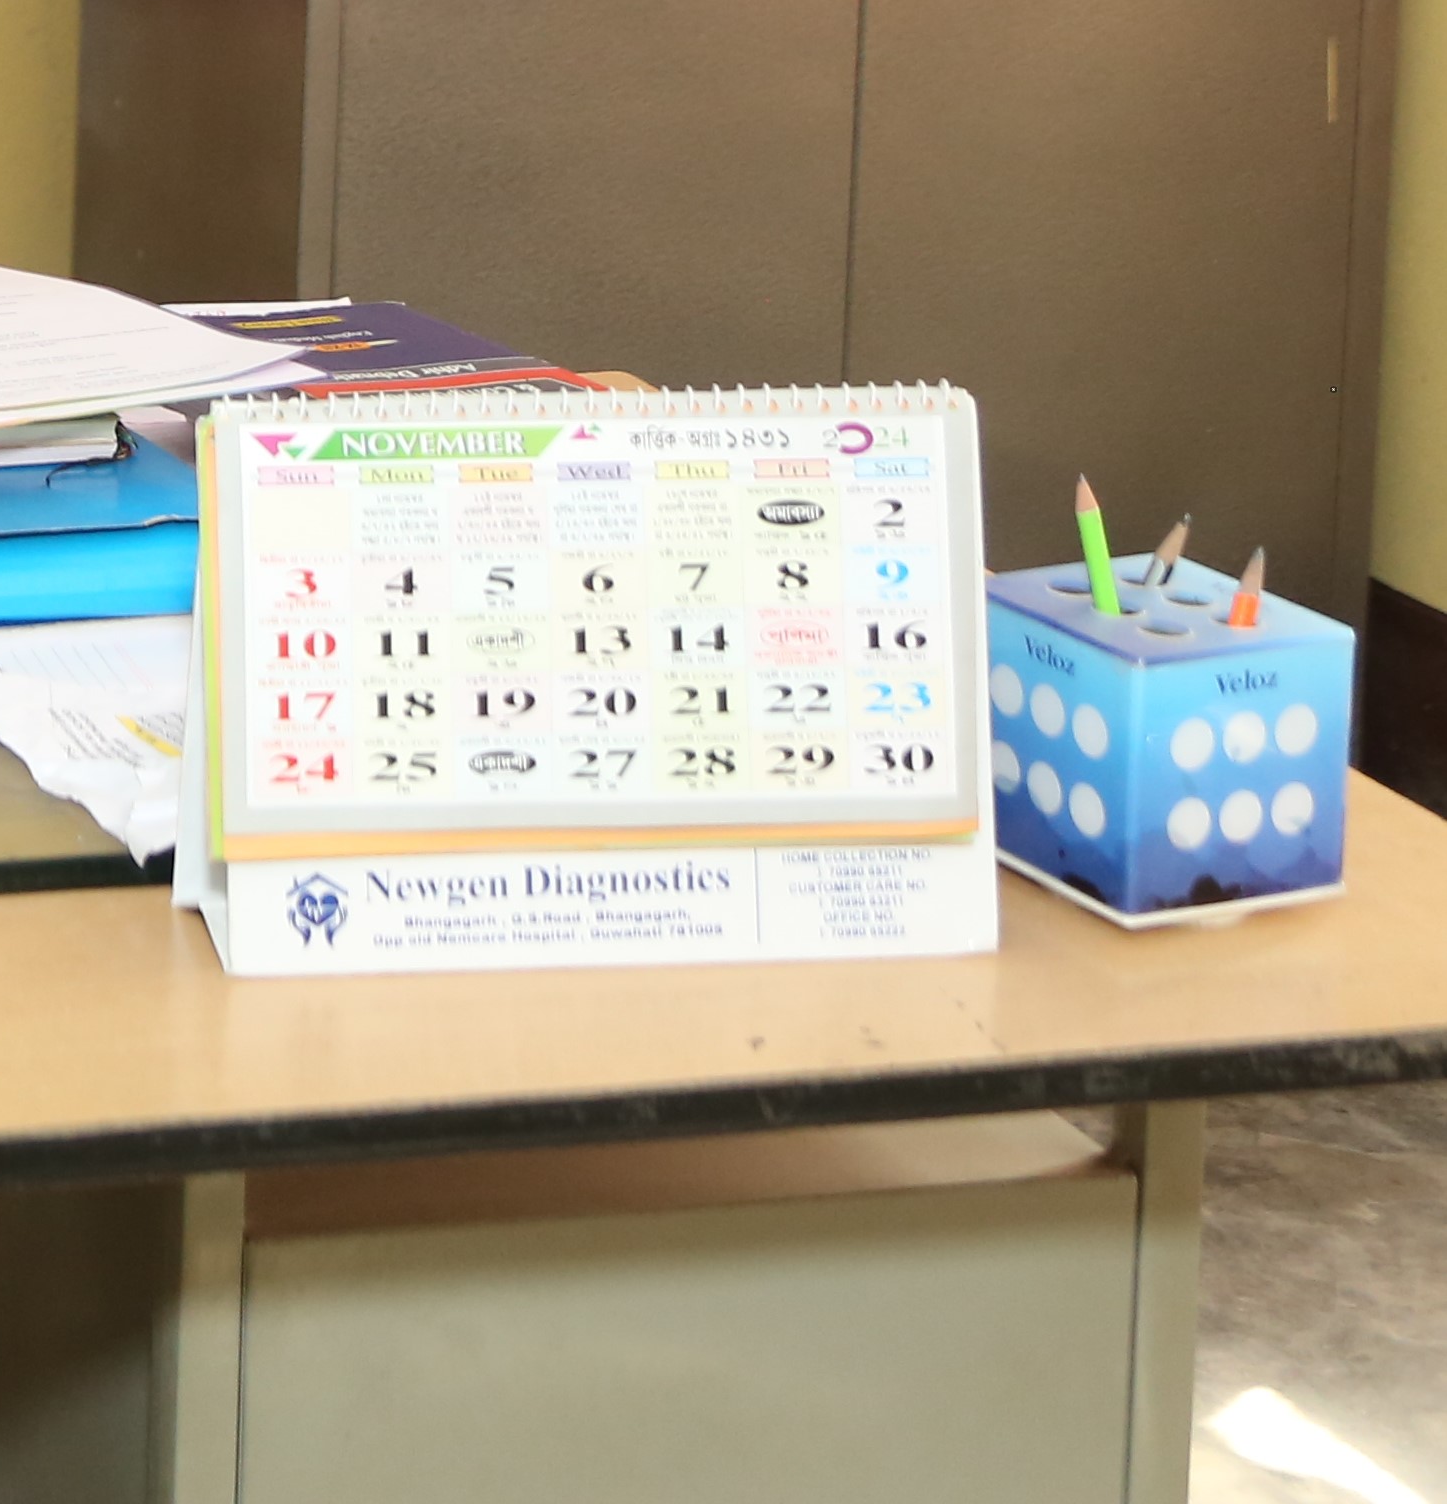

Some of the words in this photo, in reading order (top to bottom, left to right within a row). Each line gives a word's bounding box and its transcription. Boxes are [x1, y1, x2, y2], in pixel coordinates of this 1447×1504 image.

[420, 362, 477, 378] Adhir
[341, 431, 527, 457] NOVEMBER
[820, 421, 910, 455] 2024
[274, 466, 319, 485] Sun
[370, 467, 425, 483] Mon
[475, 465, 519, 480] Tue
[566, 464, 623, 480] Wed
[671, 463, 715, 478] Thu
[777, 462, 809, 477] Fri
[874, 461, 909, 476] Sat
[873, 498, 906, 528] 2
[285, 567, 318, 598] 3
[384, 567, 419, 596] 4
[484, 566, 516, 596] 5
[582, 563, 615, 593] 6
[679, 563, 710, 592] 7
[777, 560, 809, 590] 8
[875, 558, 910, 587] 9
[277, 629, 337, 659] 10
[379, 629, 431, 657] 11
[573, 625, 633, 655] 13
[669, 623, 730, 652] 14
[866, 620, 929, 650] 16
[1024, 634, 1075, 677] Veloz
[1214, 668, 1278, 696] Veloz
[277, 690, 337, 721] 17
[376, 689, 437, 719] 18
[475, 687, 537, 718] 19
[569, 686, 637, 717] 20
[670, 684, 729, 714] 21
[764, 683, 832, 713] 22
[863, 682, 933, 713] 23
[270, 752, 339, 784] 24
[370, 751, 438, 783] 25
[569, 748, 637, 779] 27
[668, 746, 737, 777] 28
[765, 745, 836, 775] 29
[863, 743, 935, 774] 30
[780, 851, 820, 865] HOME
[823, 848, 908, 863] COLLECTION
[365, 869, 508, 907] Newgen
[523, 860, 731, 901] Diagnostics
[788, 880, 862, 894] CUSTOMER
[866, 880, 902, 892] CARE
[823, 910, 870, 923] OFFICE
[511, 929, 577, 945] Hospital
[590, 923, 663, 940] Guwahati
